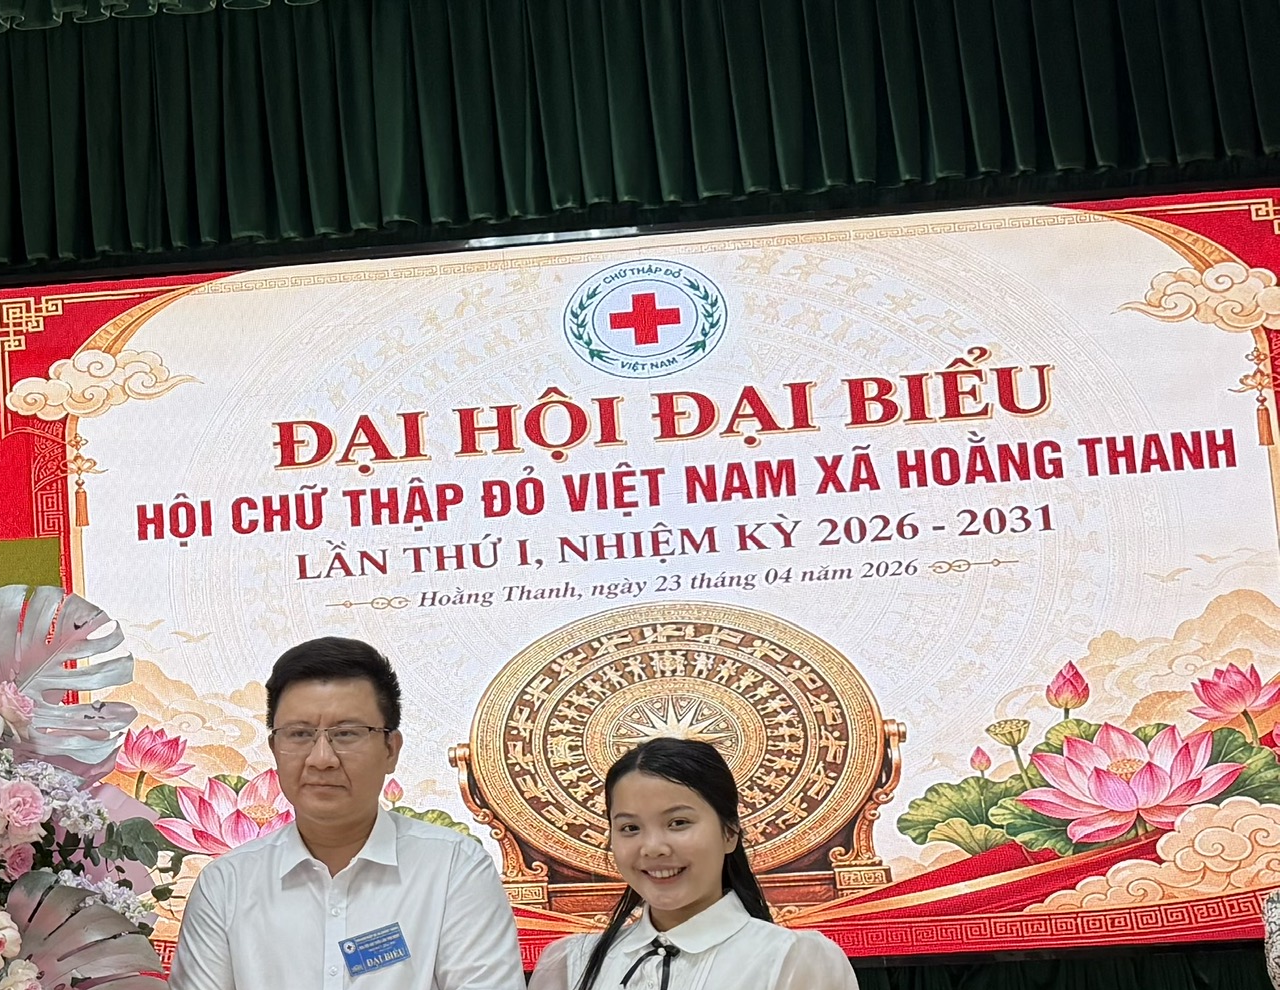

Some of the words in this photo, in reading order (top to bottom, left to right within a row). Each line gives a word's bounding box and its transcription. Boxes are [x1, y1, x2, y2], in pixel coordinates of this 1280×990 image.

[620, 361, 649, 373] VIỆT
[650, 357, 678, 370] NAM
[270, 409, 430, 477] ĐẠI
[451, 386, 624, 463] HỘI
[650, 380, 820, 447] ĐẠI
[844, 345, 1055, 430] BIỂU
[136, 493, 213, 547] HỘI
[230, 486, 328, 536] CHỮ
[342, 476, 464, 532] THẬP
[481, 465, 544, 518] ĐỎ
[561, 462, 665, 517] VIỆT
[684, 458, 799, 504] NAM
[814, 445, 886, 496] XÃ
[897, 429, 1064, 490] HOẰNG
[1077, 428, 1239, 479] THANH
[294, 540, 388, 581] LẦN
[403, 533, 505, 574] THỨ
[517, 537, 544, 570] I,
[557, 522, 718, 564] NHIỆM
[735, 513, 802, 553] KỲ
[817, 511, 920, 548] 2026
[956, 503, 1056, 540] 2031
[418, 579, 494, 610] Hoằng
[502, 582, 583, 603] Thanh,
[590, 576, 646, 600] ngày
[653, 573, 683, 594] 23
[689, 568, 759, 595] tháng
[763, 568, 793, 587] 04
[799, 564, 854, 585] năm
[860, 558, 919, 580] 2026
